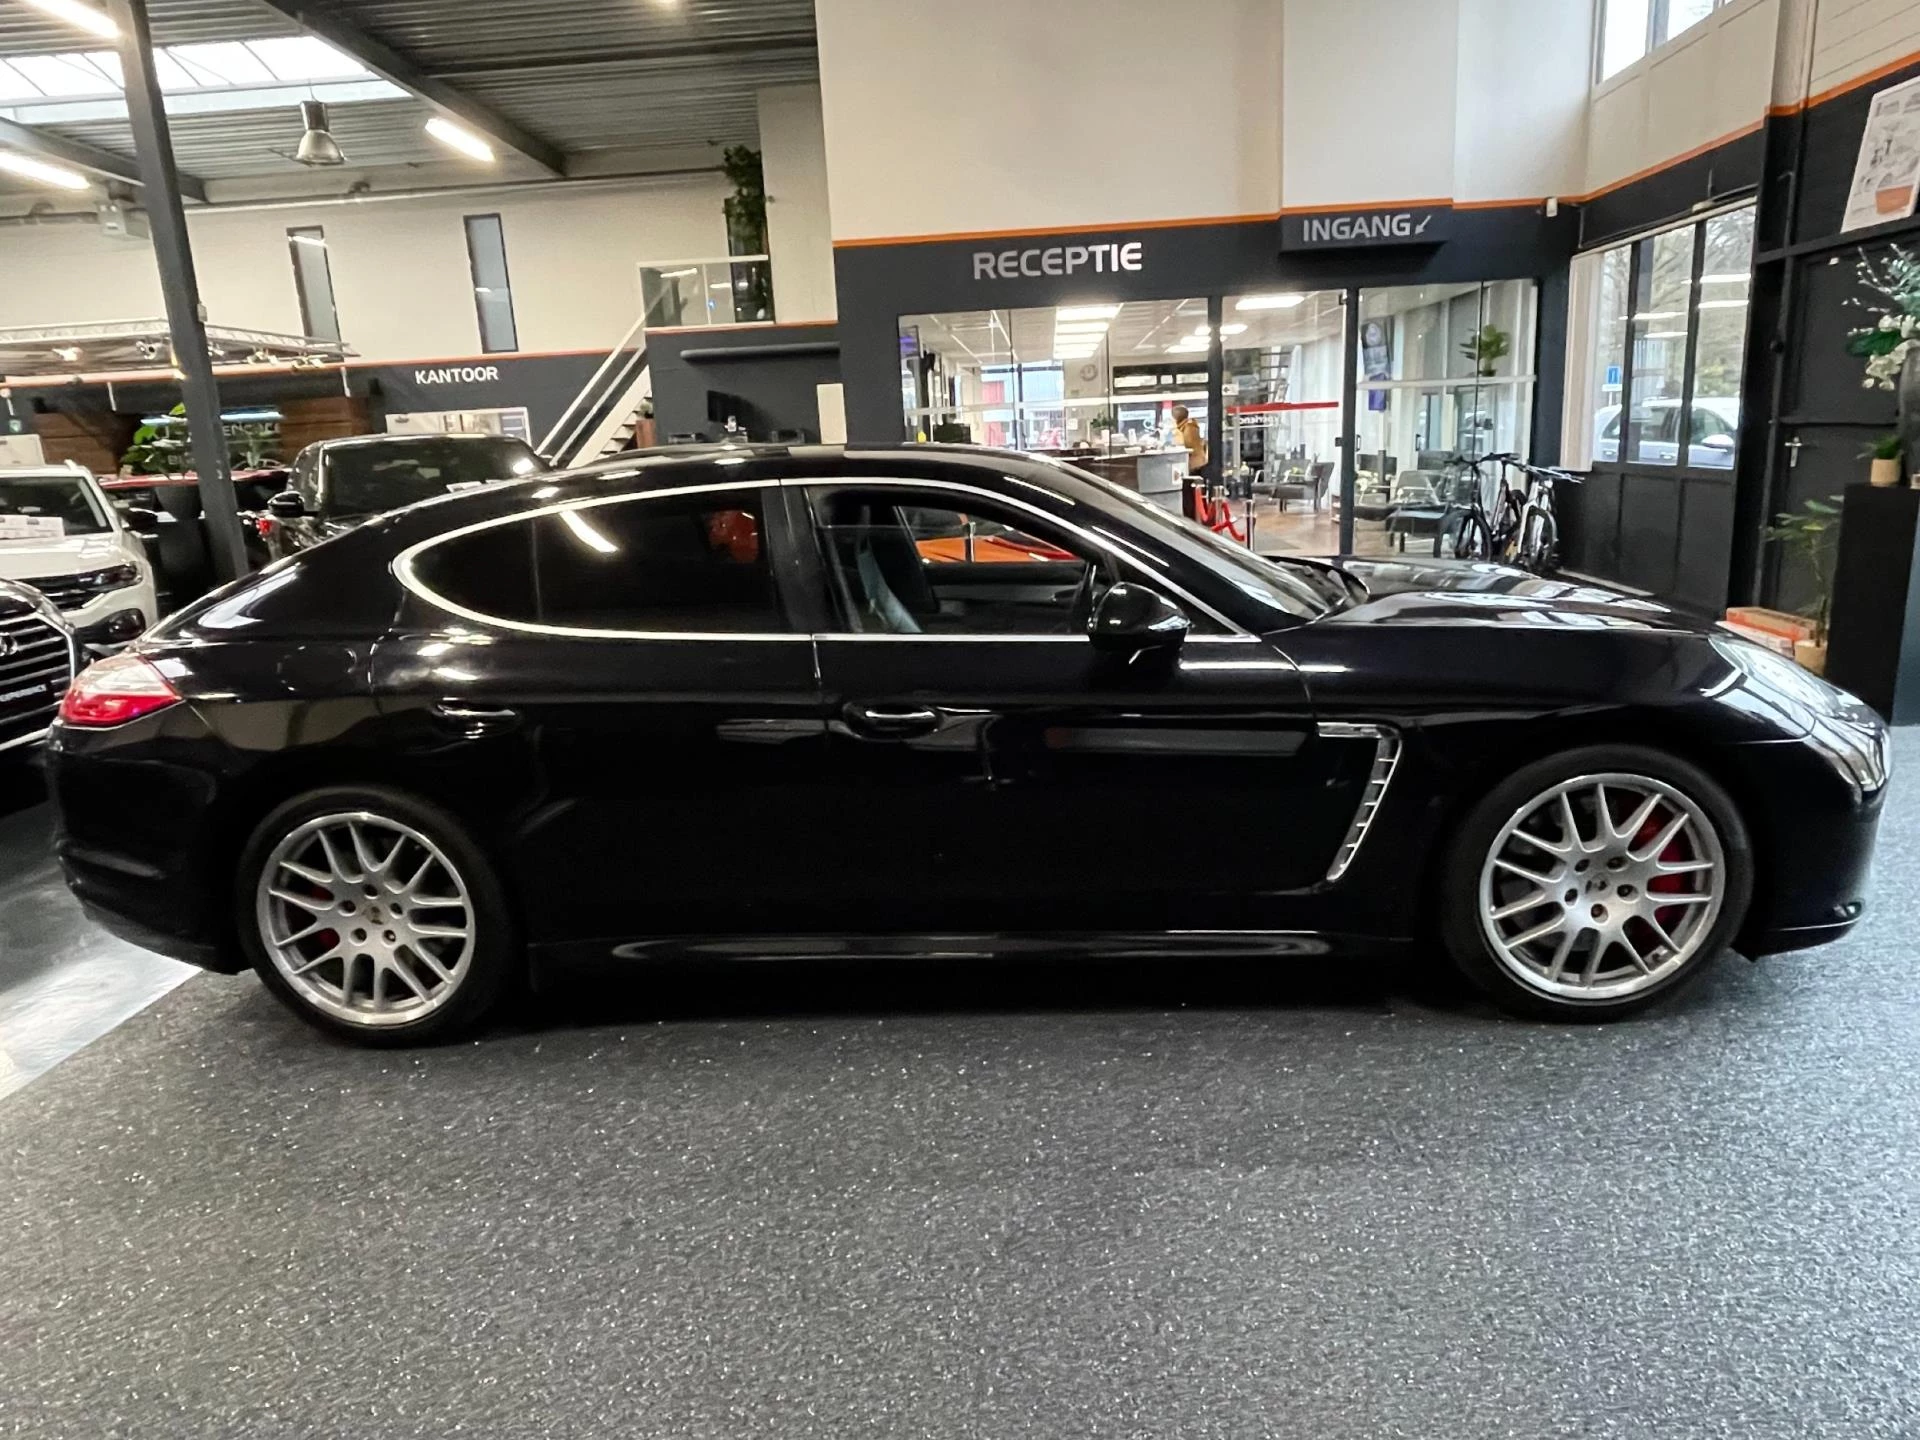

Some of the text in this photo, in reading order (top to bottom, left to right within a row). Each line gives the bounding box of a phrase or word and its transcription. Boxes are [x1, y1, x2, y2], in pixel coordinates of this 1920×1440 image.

[1303, 213, 1411, 242] INGANG
[972, 242, 1143, 280] RECEPTIE
[415, 366, 500, 385] KANTOOR
